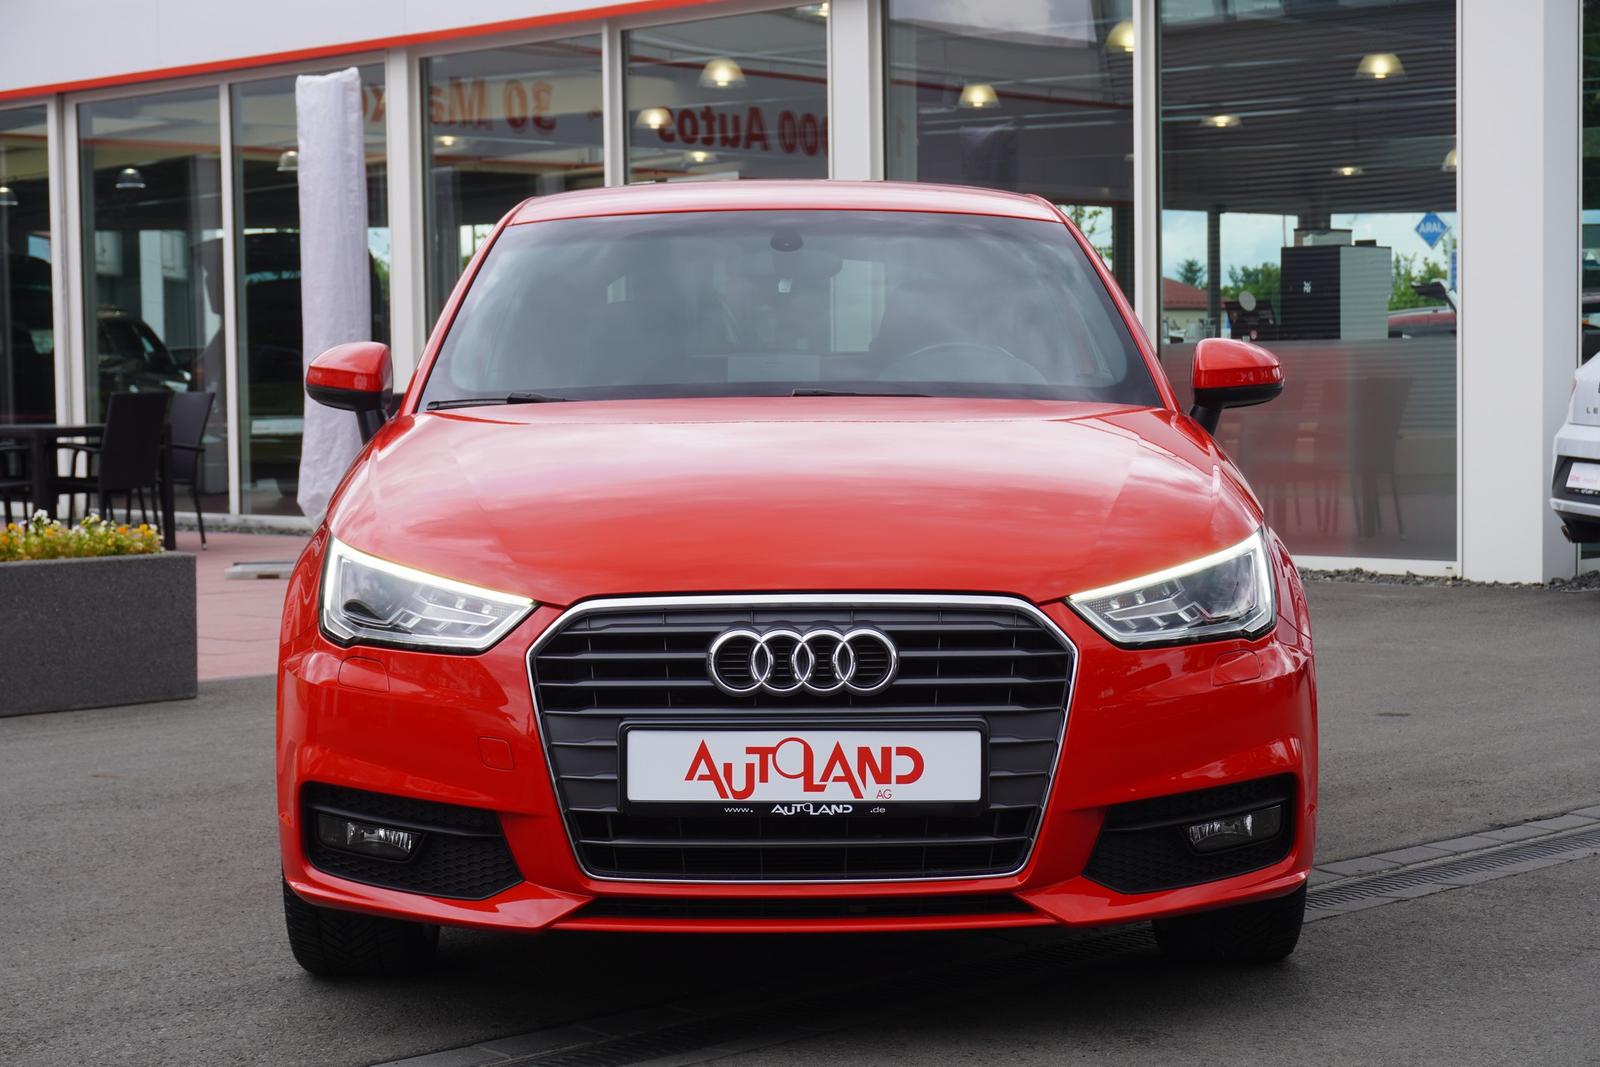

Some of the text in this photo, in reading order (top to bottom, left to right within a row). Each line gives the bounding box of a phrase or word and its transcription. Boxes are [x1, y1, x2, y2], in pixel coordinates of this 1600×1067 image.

[1418, 221, 1442, 233] ARAL
[684, 737, 925, 800] AUTOLAND
[876, 788, 893, 800] AG
[724, 802, 886, 816] www. AUTOLAND .de
